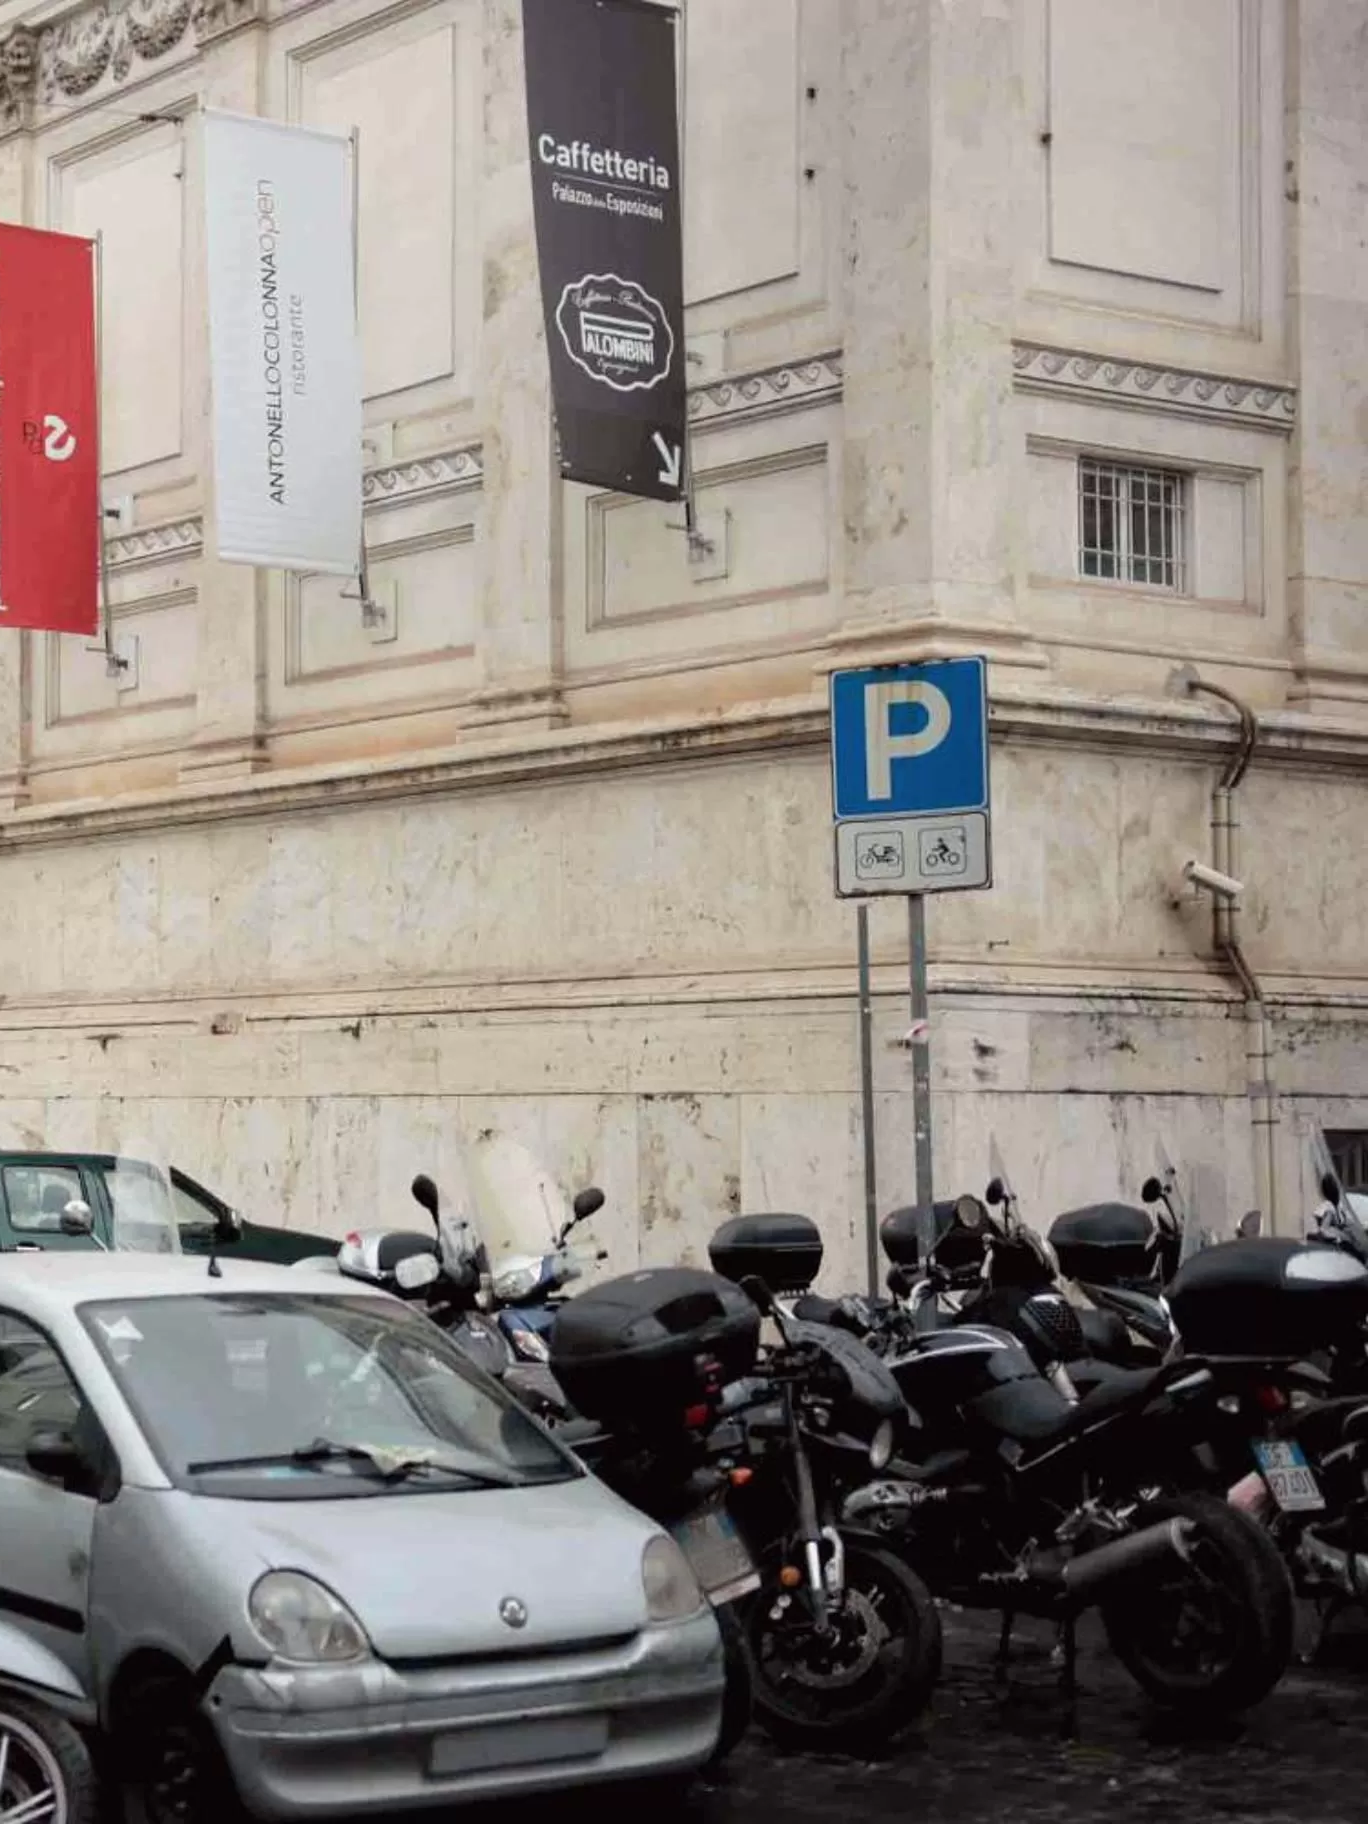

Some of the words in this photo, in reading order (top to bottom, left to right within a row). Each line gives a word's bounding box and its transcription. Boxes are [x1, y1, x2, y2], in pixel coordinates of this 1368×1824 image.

[538, 133, 670, 189] Caffetteria
[552, 181, 593, 206] Palazzo
[864, 680, 952, 801] P
